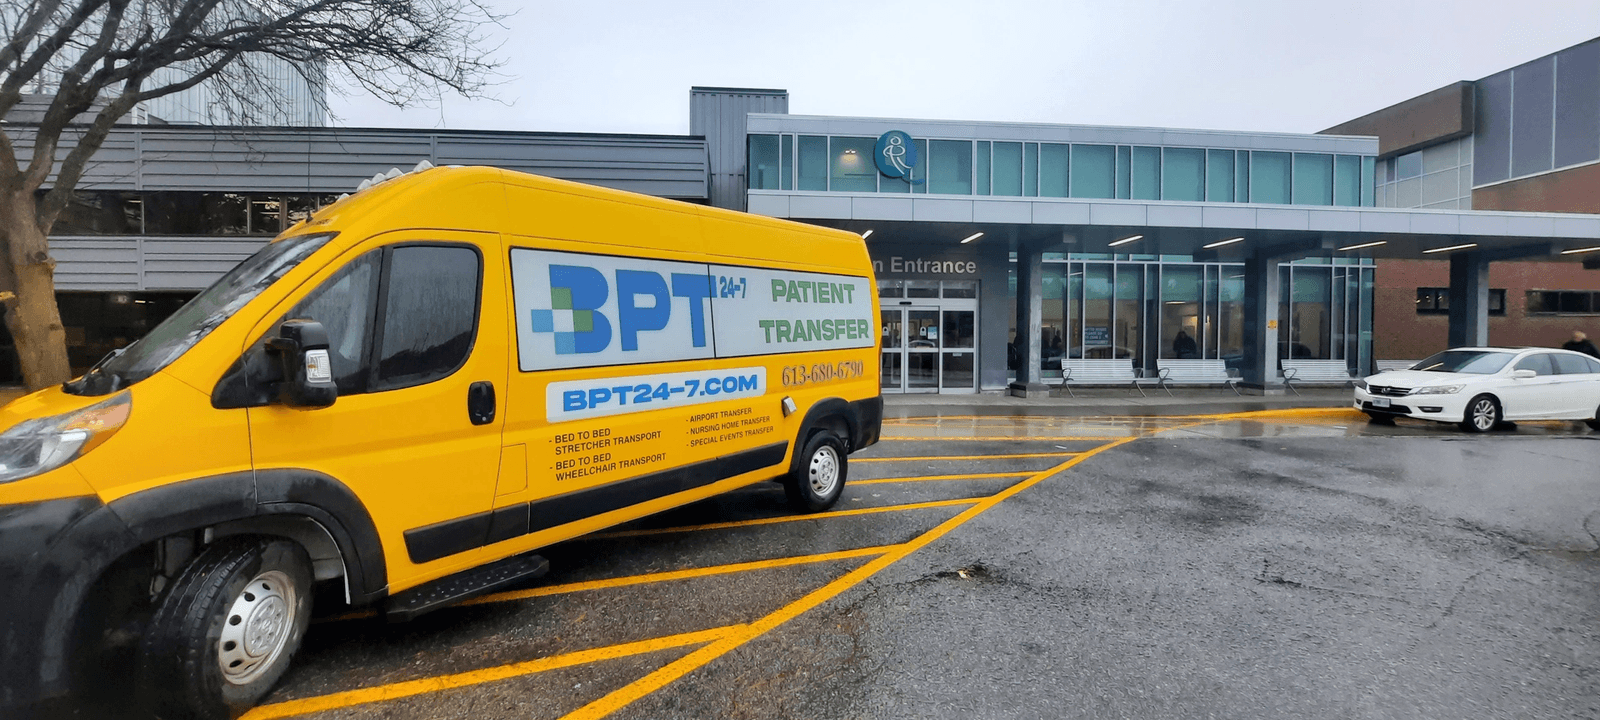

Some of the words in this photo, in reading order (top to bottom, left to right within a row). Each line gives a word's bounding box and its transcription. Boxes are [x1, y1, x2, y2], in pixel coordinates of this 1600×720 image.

[890, 256, 977, 274] Entrance
[771, 278, 856, 304] PATIENT
[549, 264, 717, 354] BPT
[719, 275, 747, 299] 24-7
[759, 318, 870, 343] TRANSFER
[781, 360, 864, 388] 613-680-6790
[562, 374, 758, 412] BPT24-7.COM
[690, 411, 719, 423] AIRPORT
[720, 407, 753, 418] TRANSFER
[690, 423, 720, 435] NURSING
[721, 420, 740, 430] HOME
[741, 415, 771, 426] TRANSFER
[554, 432, 575, 444] BED
[577, 430, 590, 441] TO
[592, 427, 611, 438] BED
[555, 439, 611, 456] STRETCHER
[613, 430, 662, 446] TRANSPORT
[690, 435, 718, 448] SPECIAL
[719, 431, 744, 442] EVENTS
[744, 425, 774, 437] TRANSFER
[555, 458, 576, 471] BED
[578, 456, 591, 466] TO
[593, 452, 612, 464] BED
[555, 462, 617, 482] WHEELCHAIR
[618, 452, 667, 470] TRANSPORT
